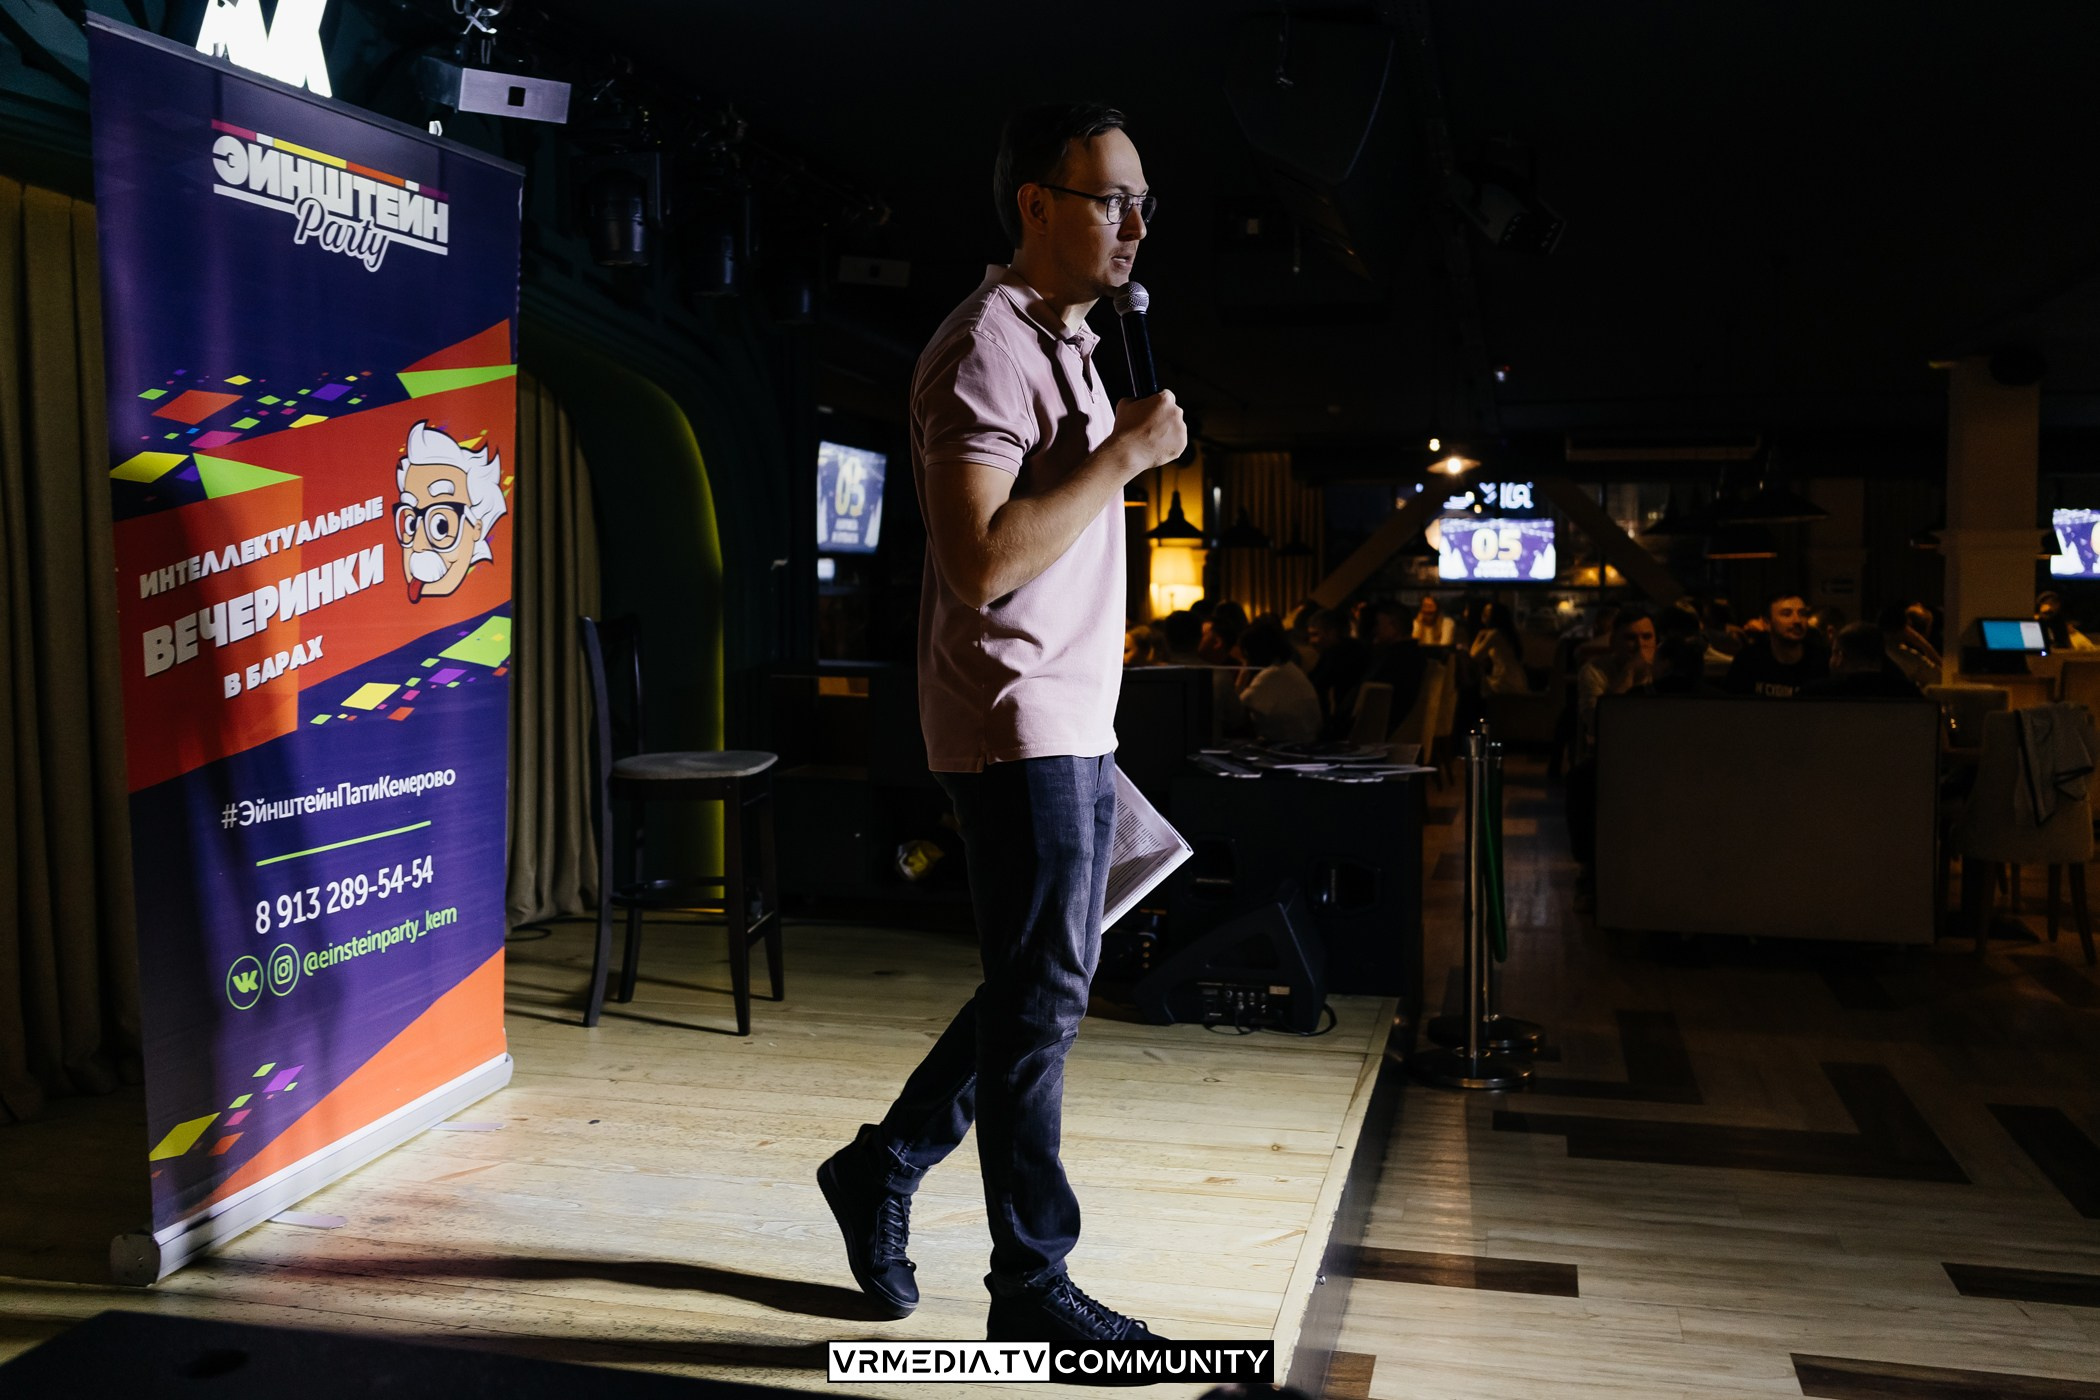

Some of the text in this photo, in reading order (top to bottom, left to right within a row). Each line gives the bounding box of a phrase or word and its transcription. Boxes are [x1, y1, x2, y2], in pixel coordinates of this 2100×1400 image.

[212, 133, 449, 244] ЭЙНШТЕЙН
[295, 197, 389, 271] Party
[140, 496, 384, 599] ИНТЕЛЛЕКТУАЛЬНЫЕ
[1472, 528, 1522, 561] 05
[143, 544, 385, 677] ВЕЧЕРИНКИ
[224, 635, 324, 699] В БАРАХ
[221, 768, 456, 829] #ЭйнштейнПатиКемерово
[255, 855, 434, 934] 8 913 289-54-54
[303, 907, 457, 976] @einsteinparty_kem
